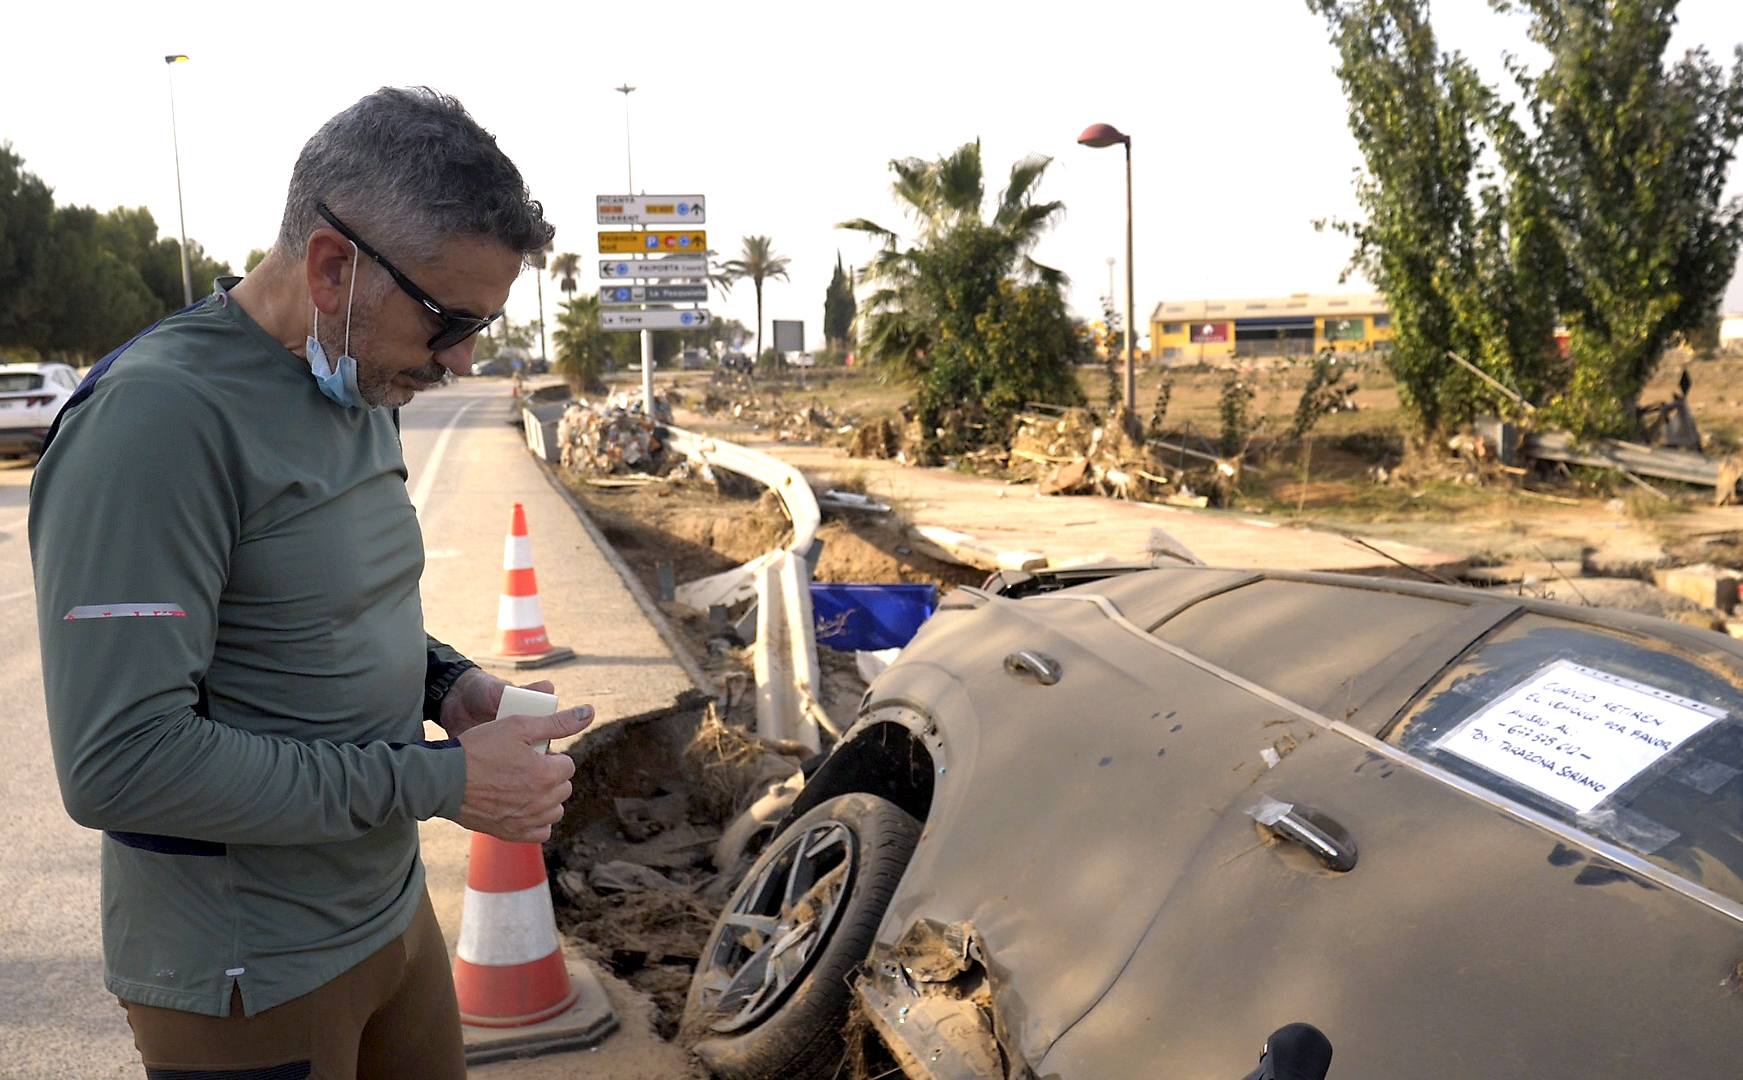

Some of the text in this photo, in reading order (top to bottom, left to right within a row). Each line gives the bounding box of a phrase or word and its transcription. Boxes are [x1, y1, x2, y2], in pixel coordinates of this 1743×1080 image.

[638, 263, 679, 271] PAIPORTA
[603, 315, 642, 324] La Torre
[1542, 682, 1667, 727] CUANDO RETIREN
[1525, 692, 1542, 703] EL
[1603, 720, 1627, 734] POR
[1629, 729, 1672, 752] FAVOR
[1498, 740, 1557, 772] TARAZONA
